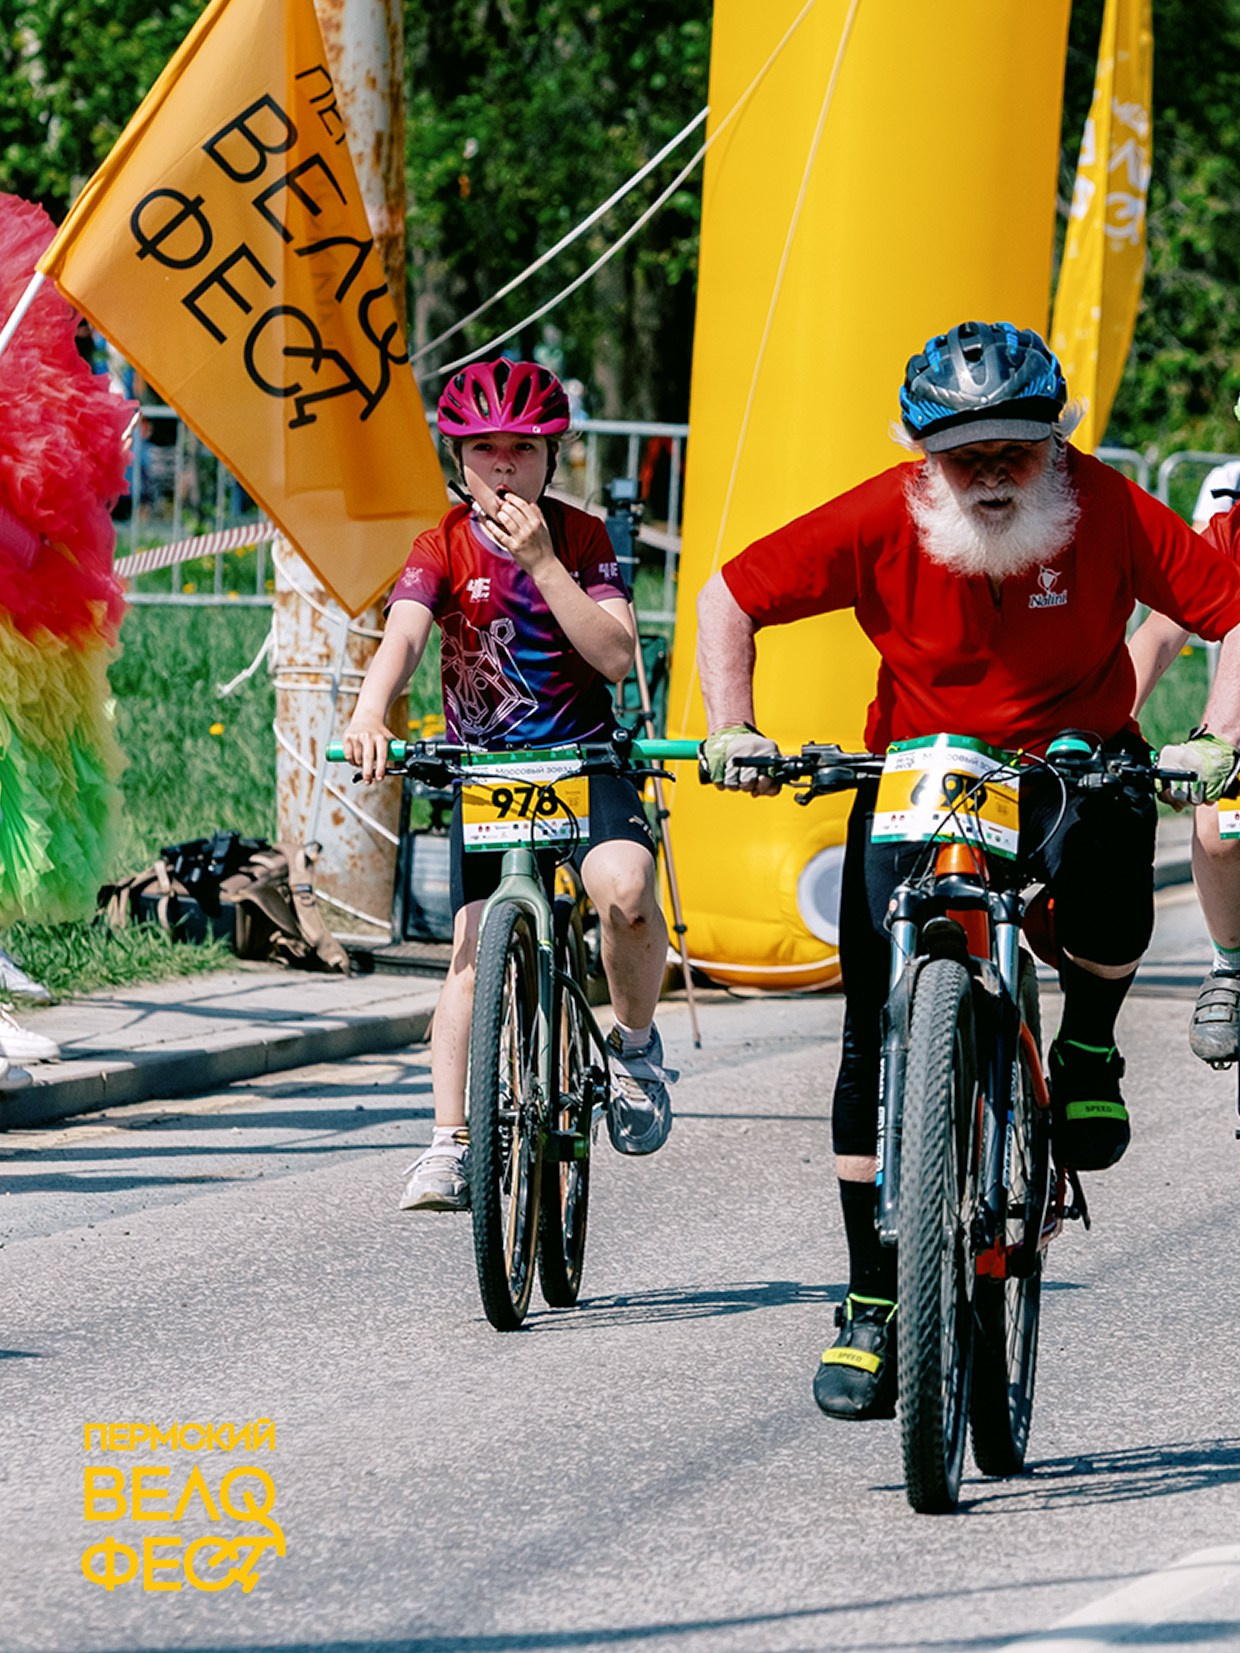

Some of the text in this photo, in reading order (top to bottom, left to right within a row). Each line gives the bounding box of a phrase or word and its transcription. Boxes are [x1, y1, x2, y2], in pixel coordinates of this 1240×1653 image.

[130, 188, 391, 429] ФЕСТ
[1028, 589, 1068, 609] Nalini
[491, 784, 558, 819] 978
[1085, 1104, 1113, 1113] SPEED
[837, 1351, 863, 1363] SPEED
